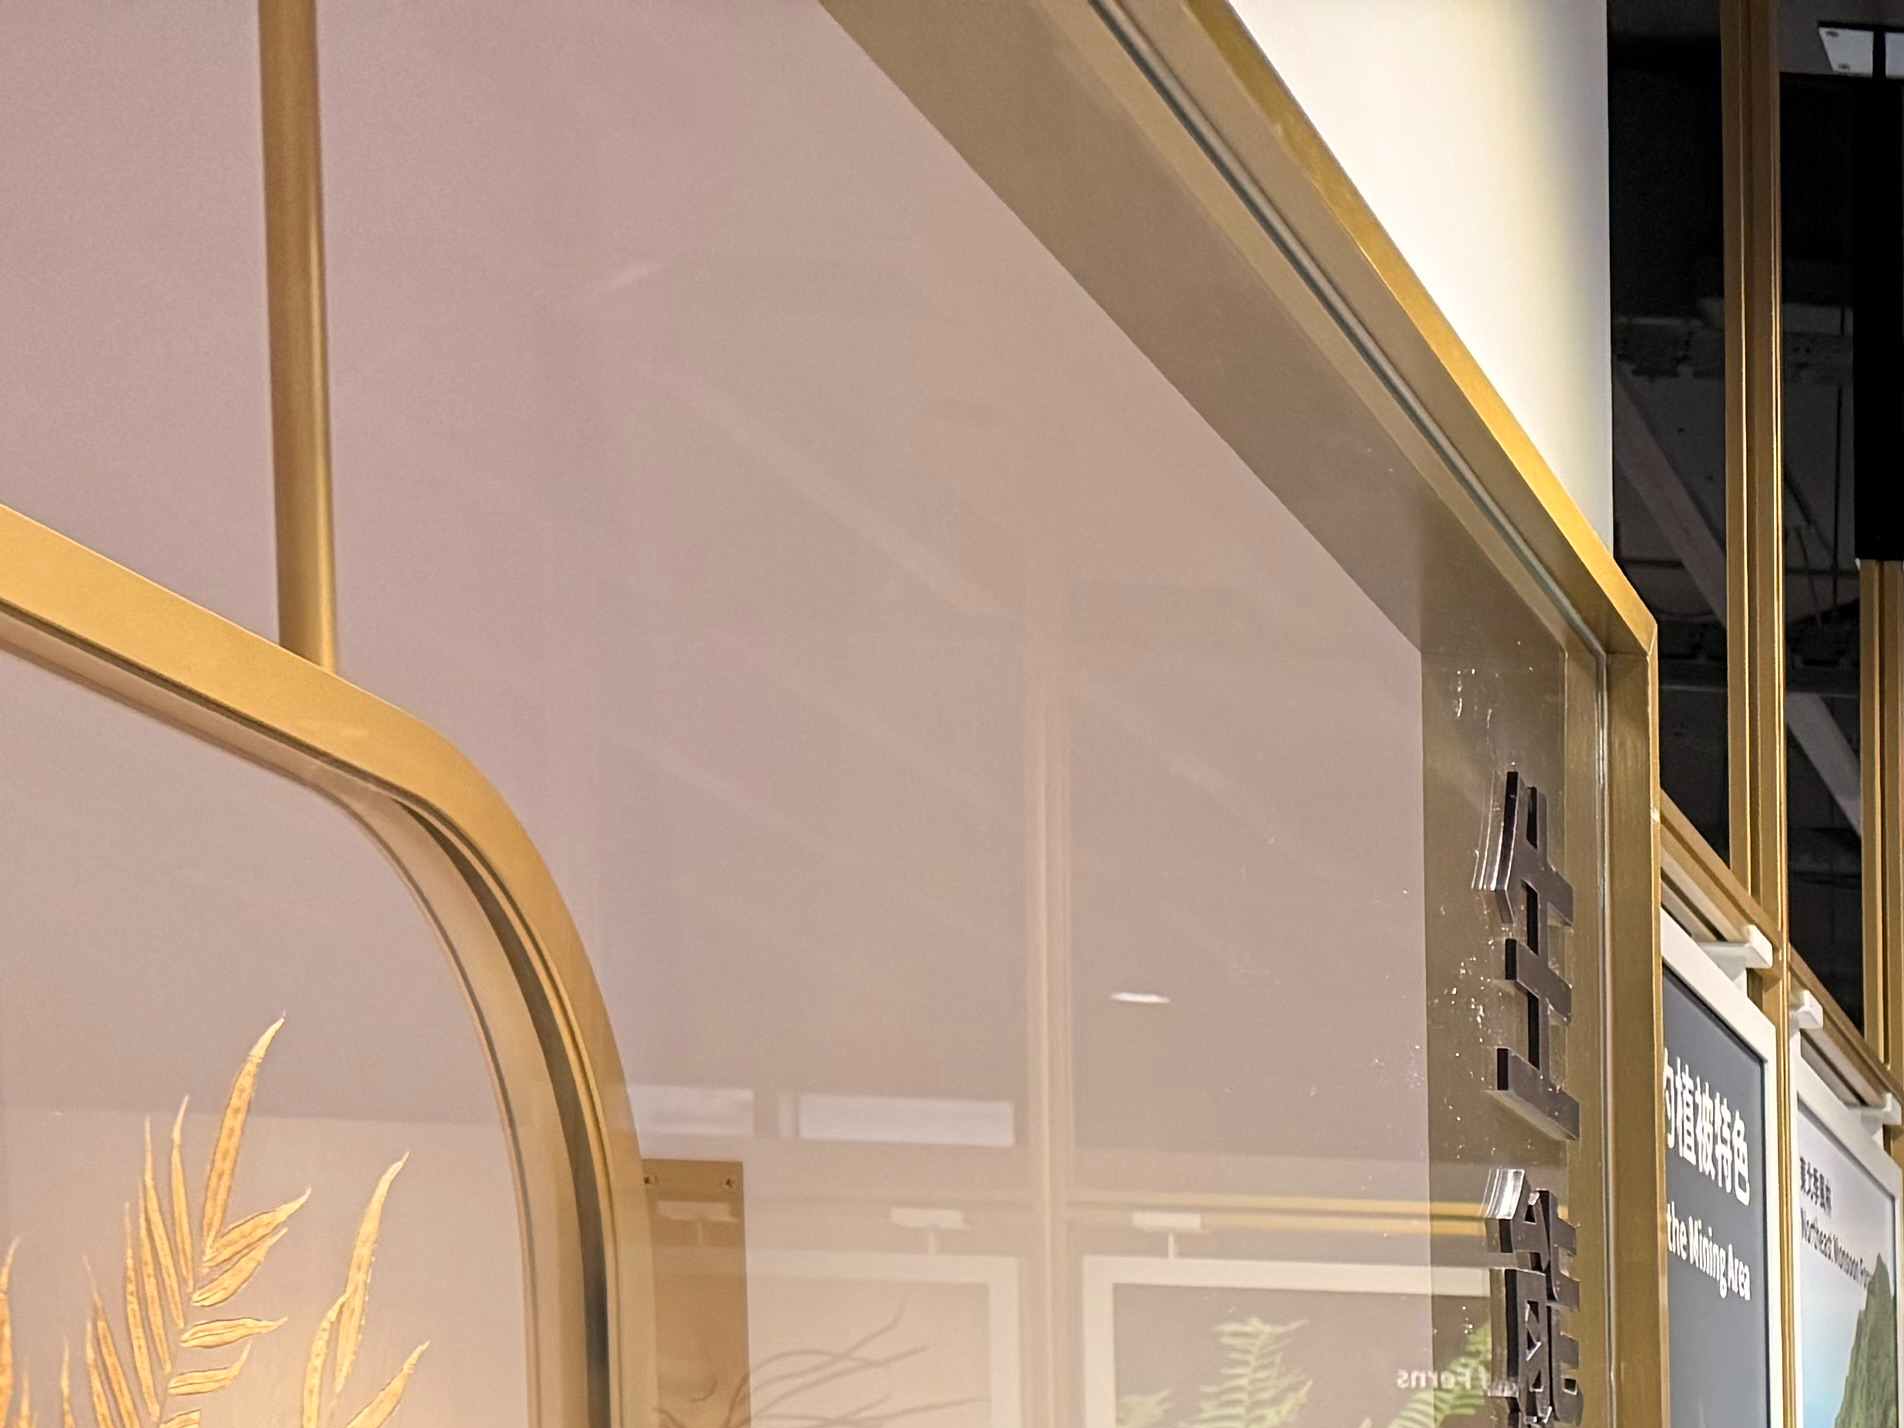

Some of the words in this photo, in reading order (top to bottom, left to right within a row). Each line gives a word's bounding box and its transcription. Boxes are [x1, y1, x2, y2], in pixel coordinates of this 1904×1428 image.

[1666, 1202, 1688, 1260] the
[1689, 1216, 1727, 1299] Mining
[1727, 1244, 1751, 1301] Area
